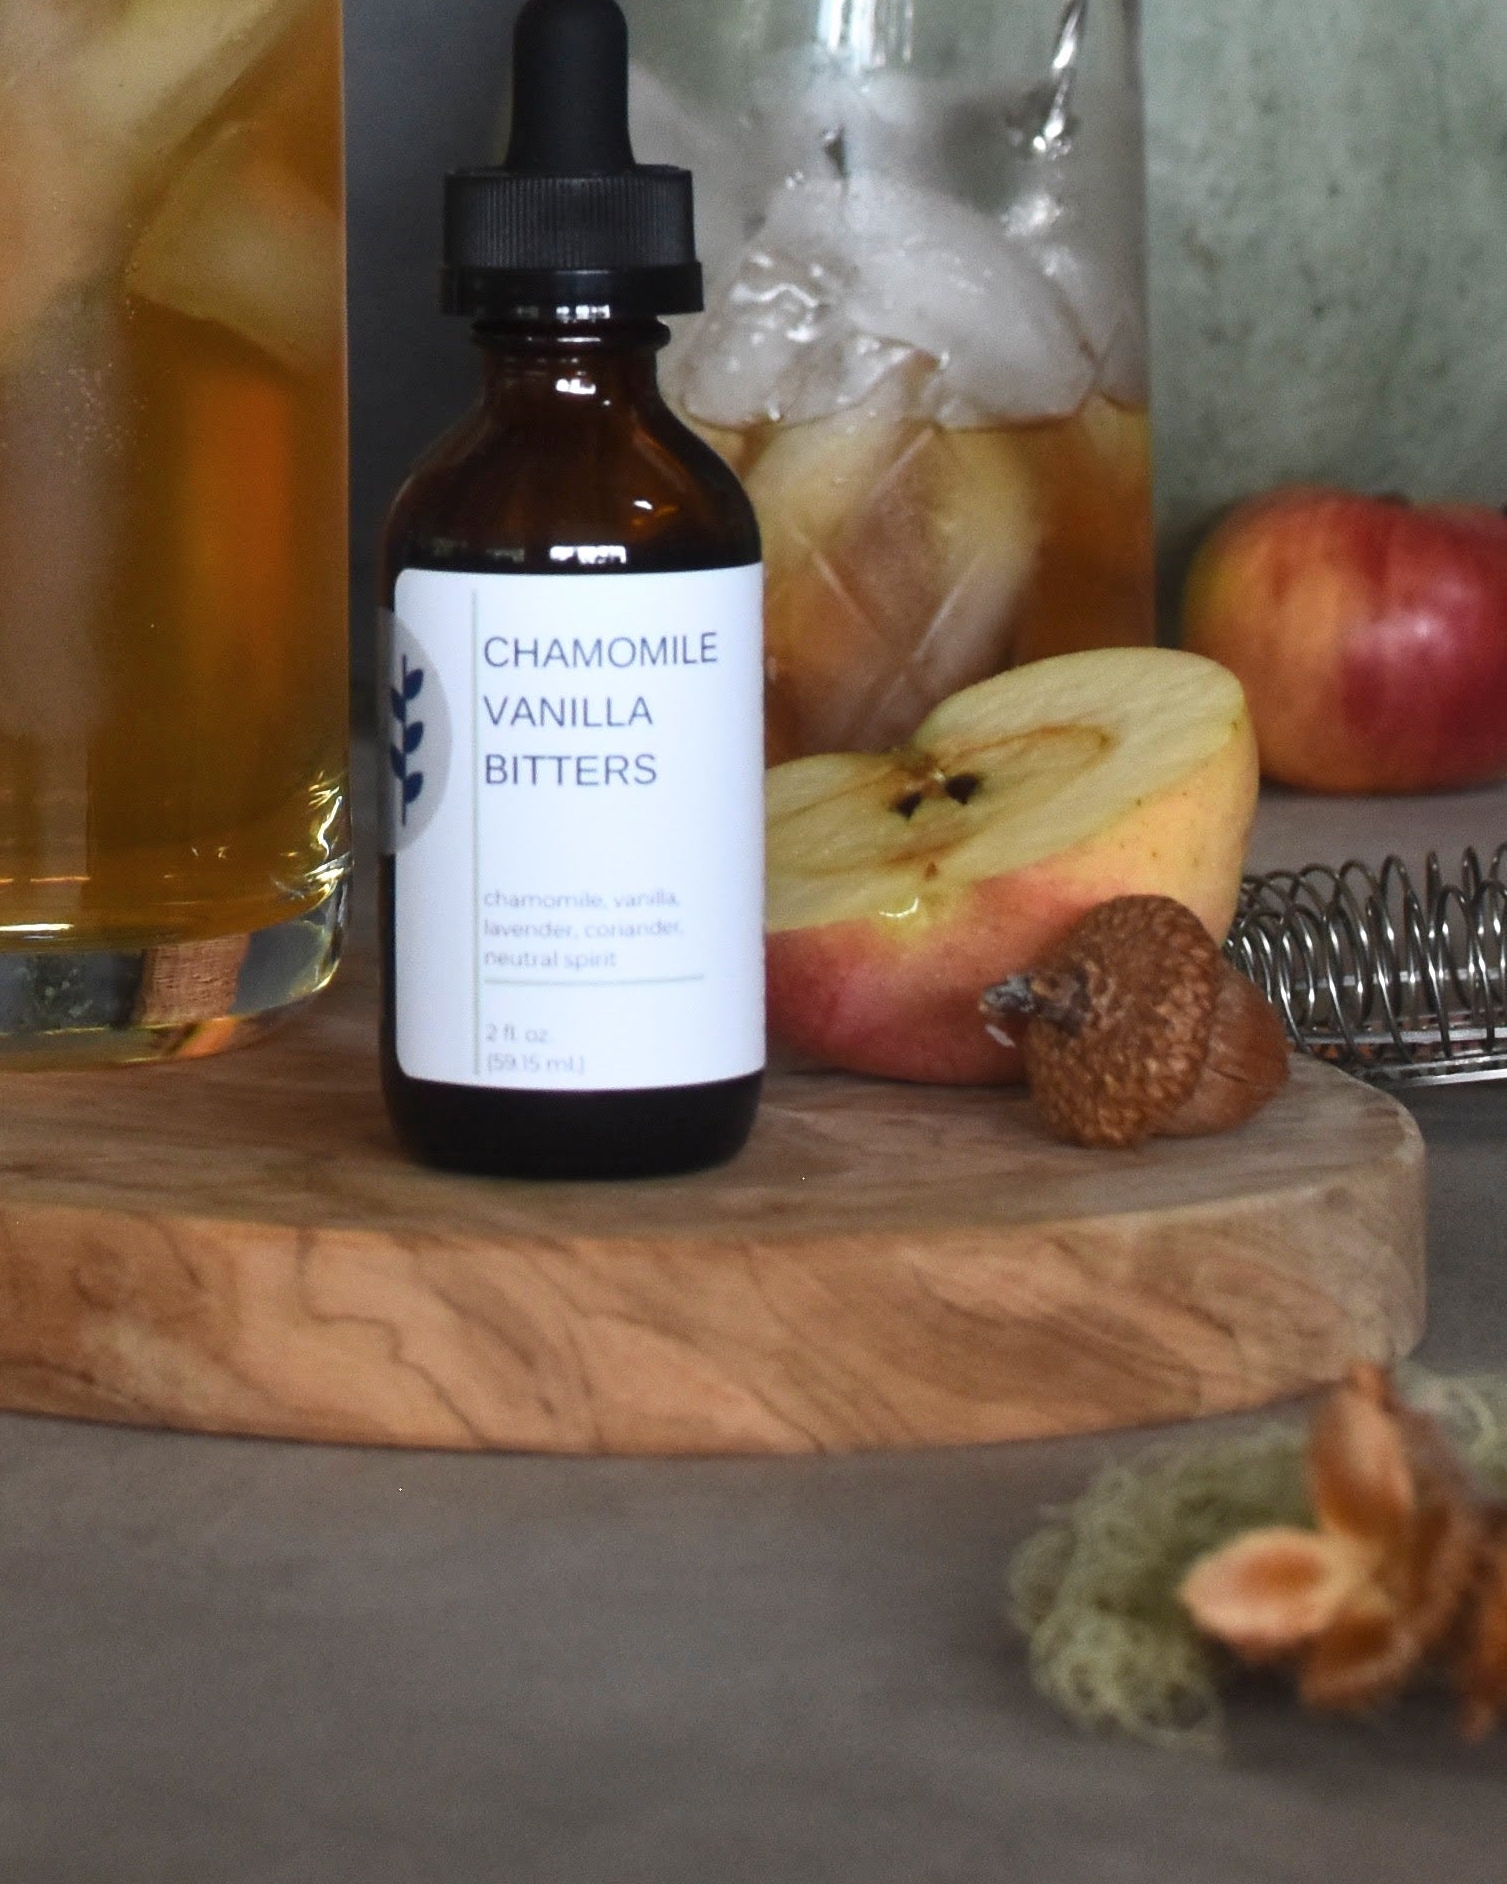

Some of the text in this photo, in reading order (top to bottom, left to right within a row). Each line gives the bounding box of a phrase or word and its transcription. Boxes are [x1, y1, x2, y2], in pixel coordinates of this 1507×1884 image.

[483, 631, 718, 668] CHAMOMILE
[483, 695, 654, 728] VANILLA
[484, 753, 658, 786] BITTERS
[483, 950, 617, 971] neutral spirit
[485, 1022, 498, 1042] 2
